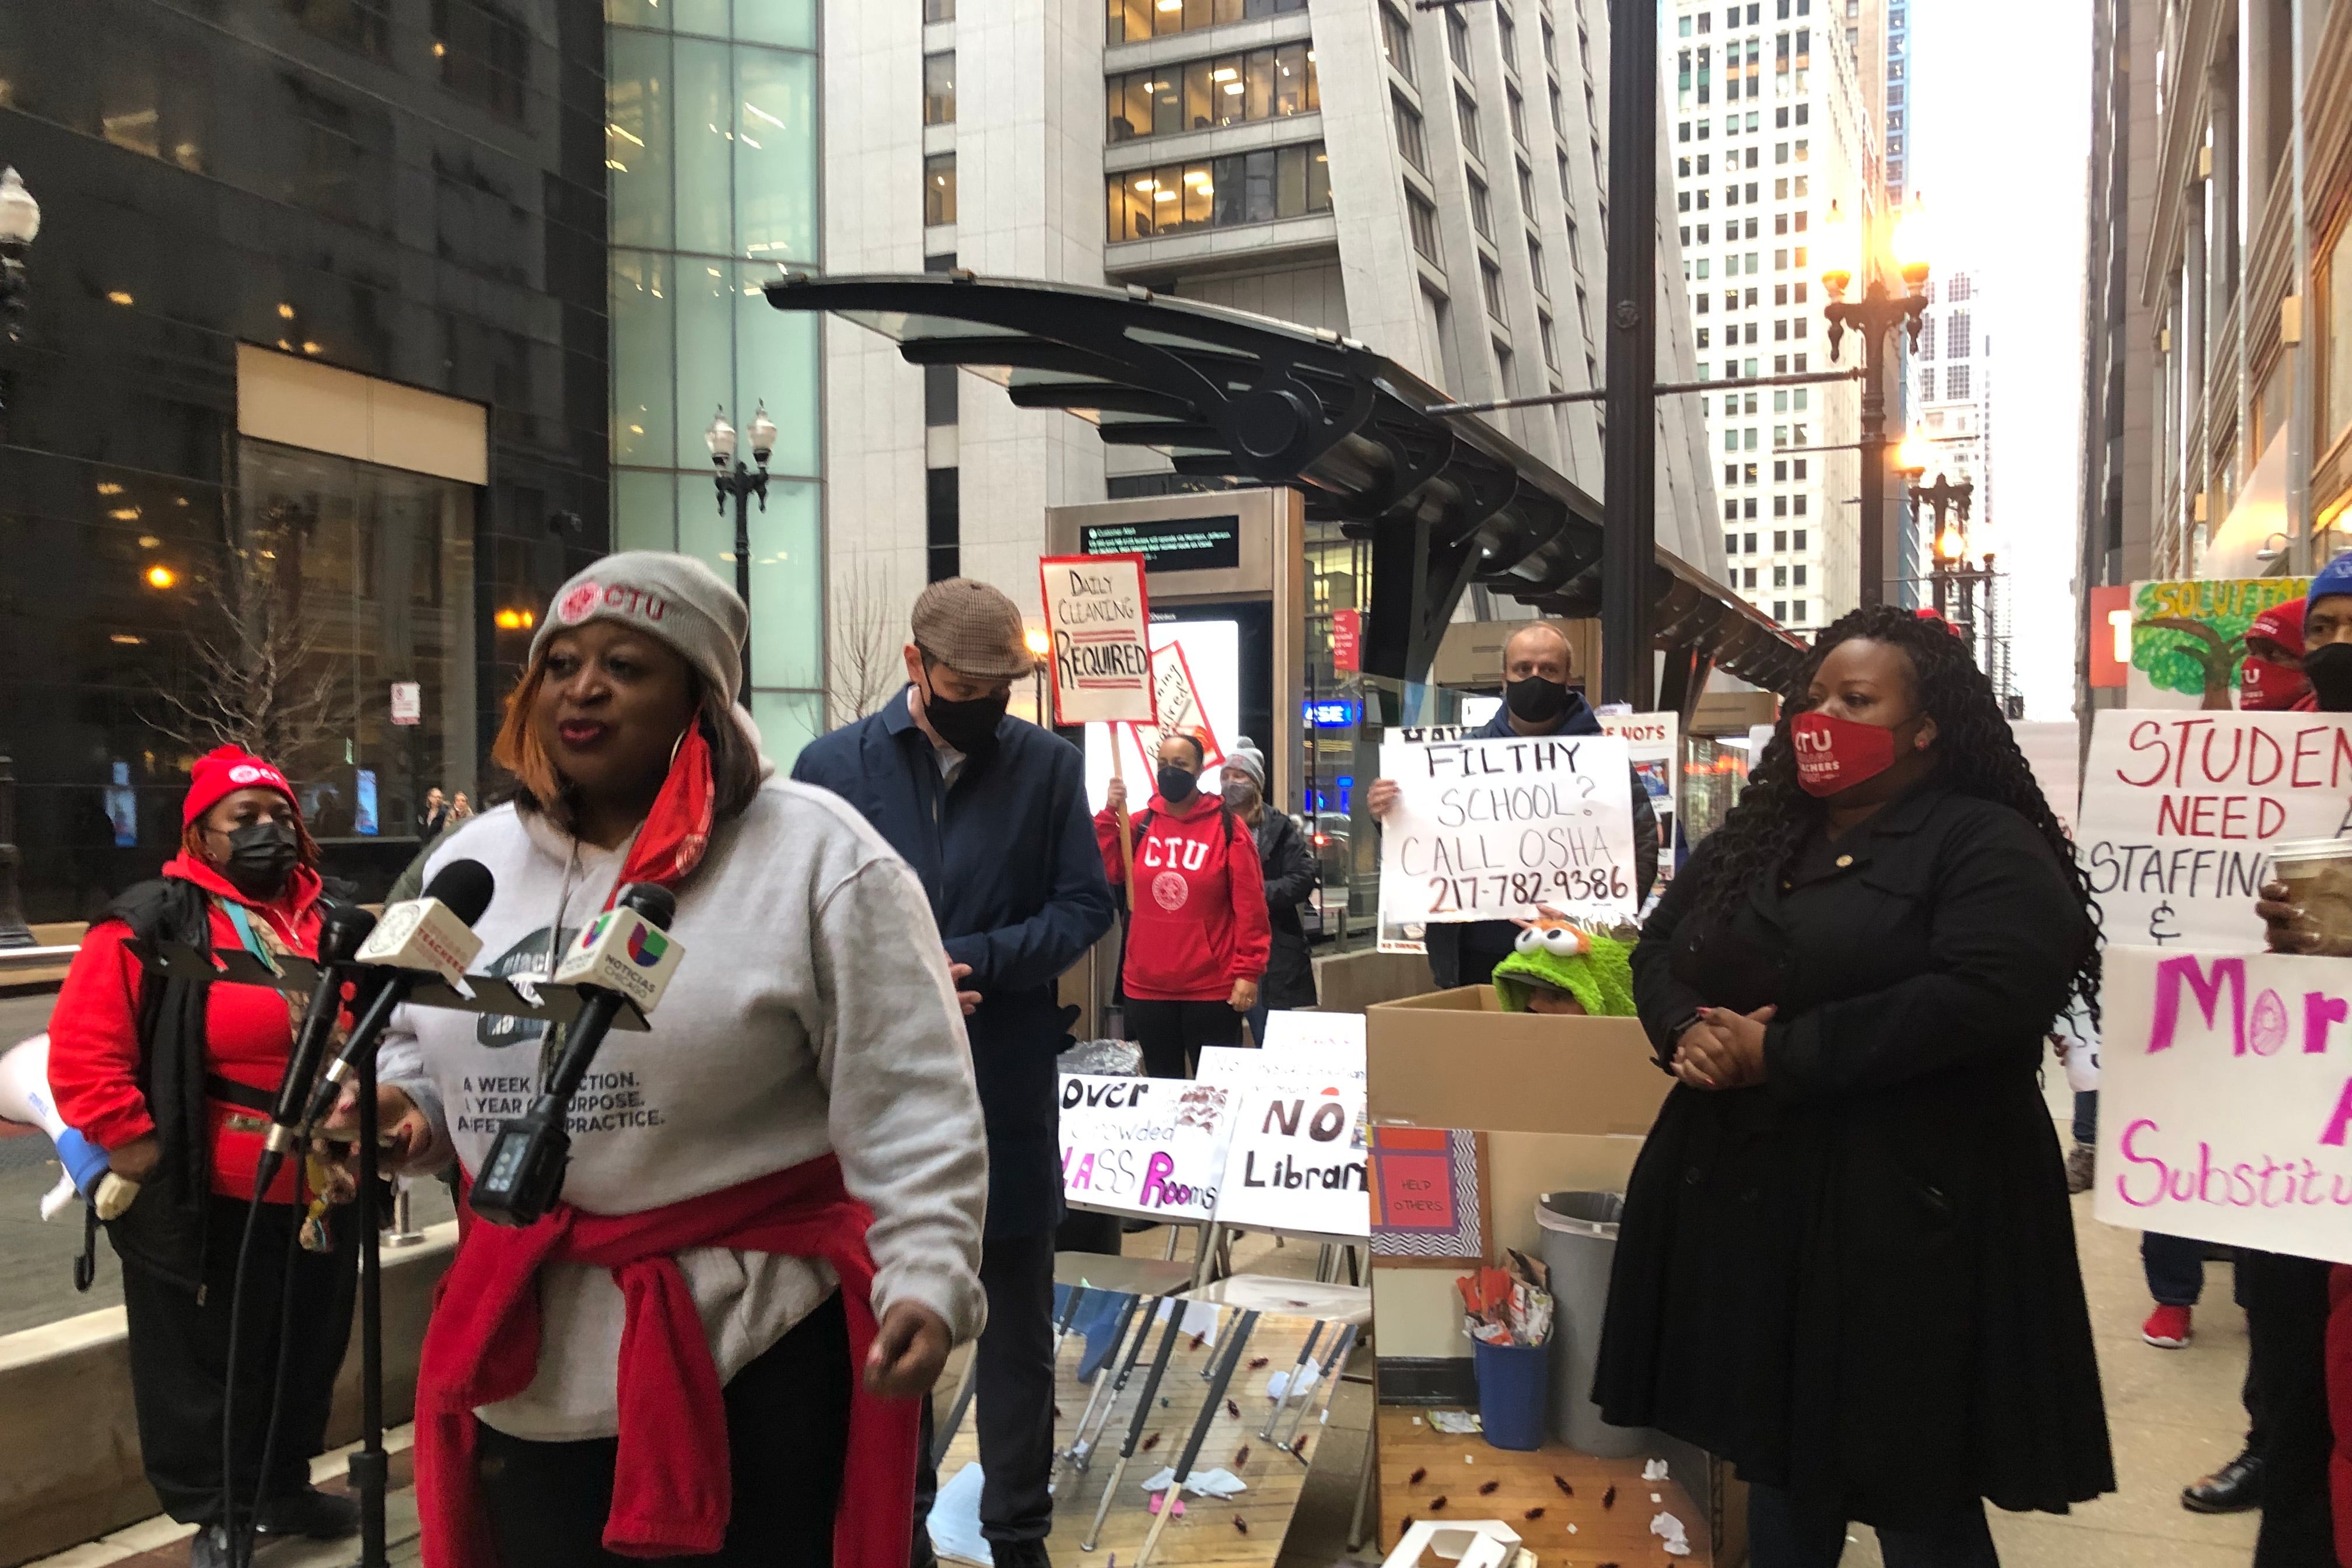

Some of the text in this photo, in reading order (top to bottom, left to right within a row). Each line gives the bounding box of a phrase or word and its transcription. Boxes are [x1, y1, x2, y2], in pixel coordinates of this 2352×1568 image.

[604, 583, 666, 621] CTU
[1069, 569, 1113, 597] DAILY
[1058, 596, 1135, 624] CLEANING
[1054, 628, 1149, 690] REQUIRED
[1424, 742, 1580, 778] FILTHY
[1437, 775, 1596, 827] SCHOOL?
[2157, 794, 2286, 840] NEED
[1144, 835, 1210, 871] CTU
[1401, 825, 1614, 876] CALL OSHA
[1428, 864, 1629, 914] 217-782-9386
[604, 965, 648, 999] CHICAGO
[605, 953, 656, 993] NOTICIAS
[2146, 954, 2351, 1057] Mor
[464, 1076, 473, 1093] A
[478, 1075, 530, 1093] WEEK
[458, 1115, 469, 1132] A
[565, 1110, 666, 1133] PRACTICE.
[475, 1097, 523, 1113] YEAR
[1261, 1099, 1345, 1142] NO
[1139, 1151, 1219, 1209] Rooms
